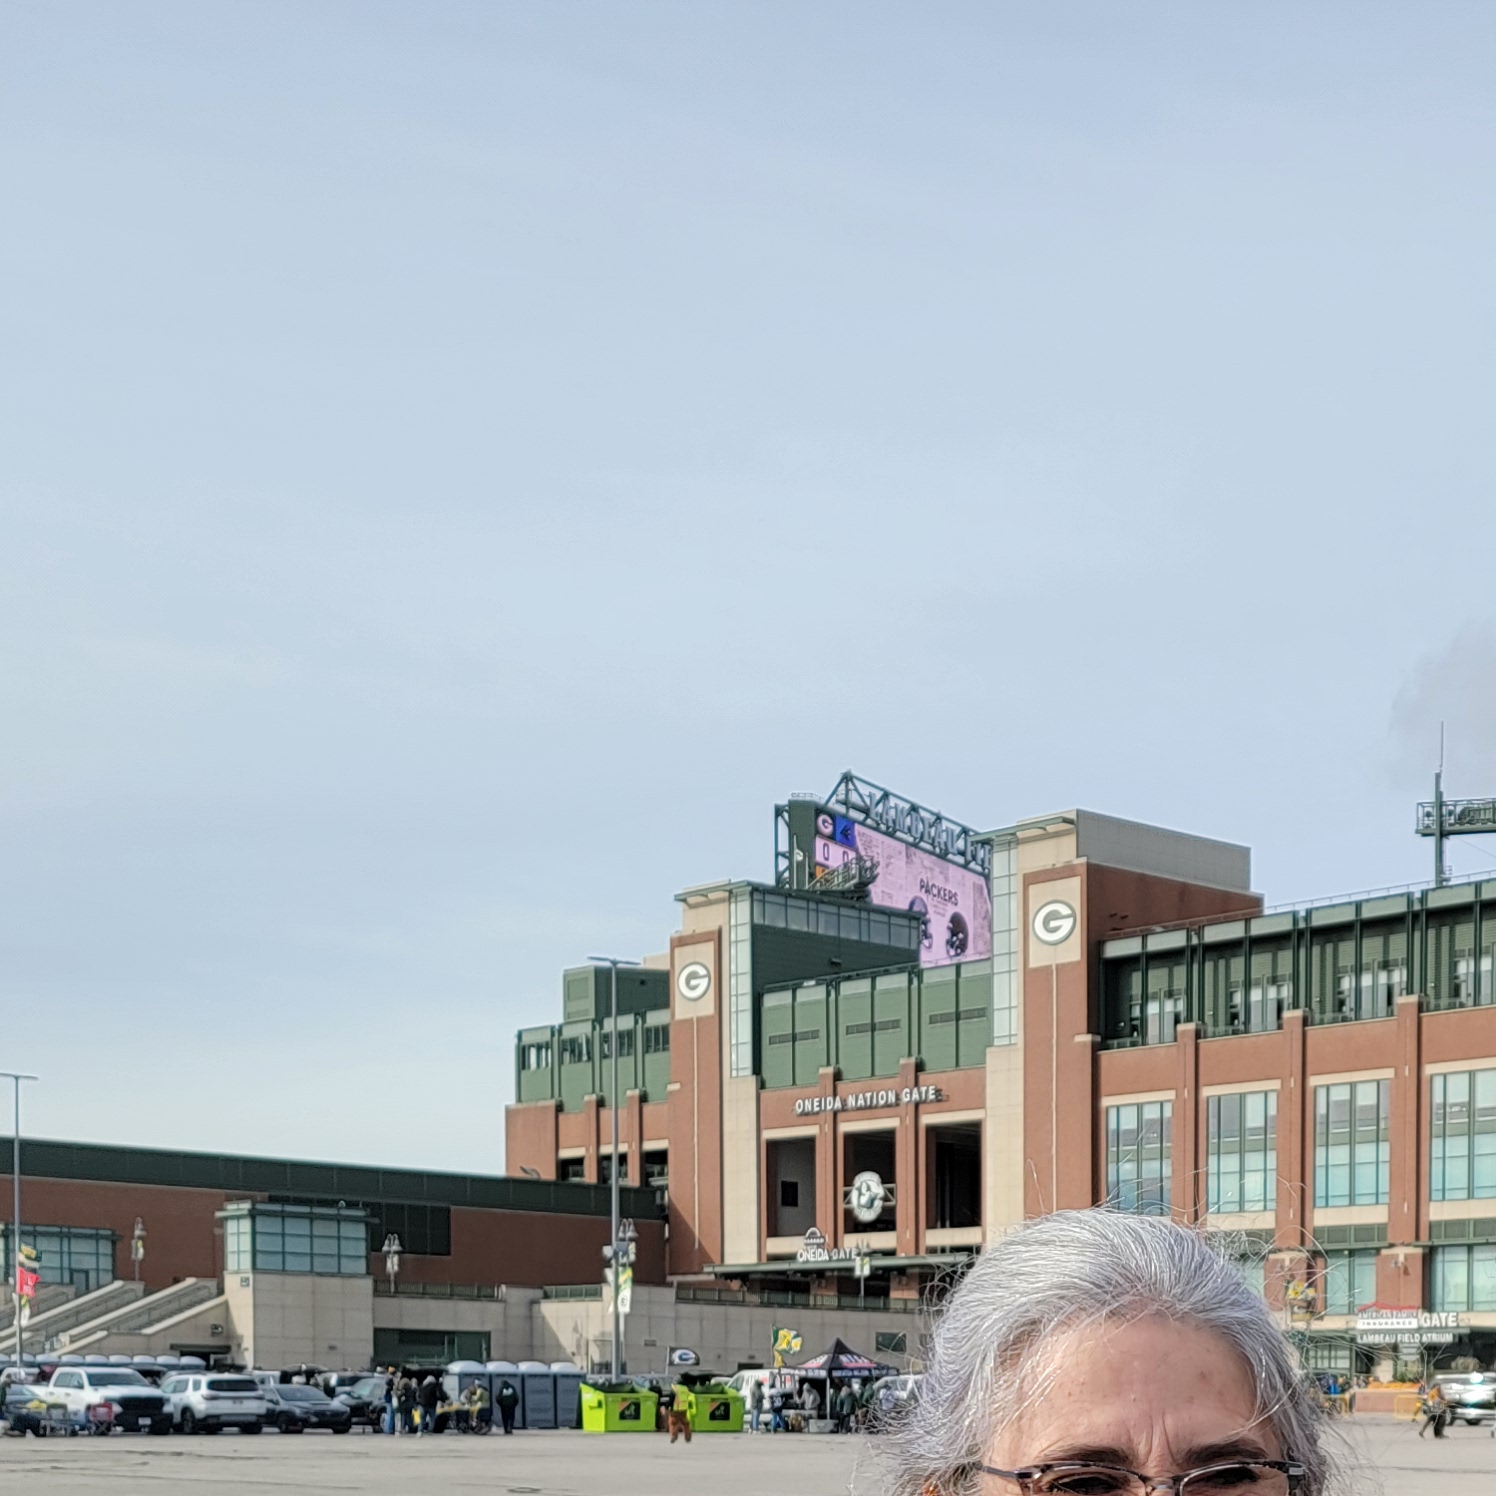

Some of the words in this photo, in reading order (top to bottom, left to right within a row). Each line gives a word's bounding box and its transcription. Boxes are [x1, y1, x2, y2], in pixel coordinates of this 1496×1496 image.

[868, 791, 959, 856] LAMBEAU
[919, 877, 959, 907] PACKERS
[1032, 900, 1076, 945] G
[678, 961, 711, 1000] G
[795, 1095, 842, 1114] ONEIDA
[848, 1089, 897, 1108] NATION
[902, 1085, 937, 1103] GATE
[797, 1248, 830, 1263] ONEIDA
[1421, 1312, 1458, 1328] GATE
[1357, 1332, 1397, 1344] LAMBEAU
[1397, 1333, 1420, 1343] FIELD
[1421, 1333, 1454, 1343] ATRIUM
